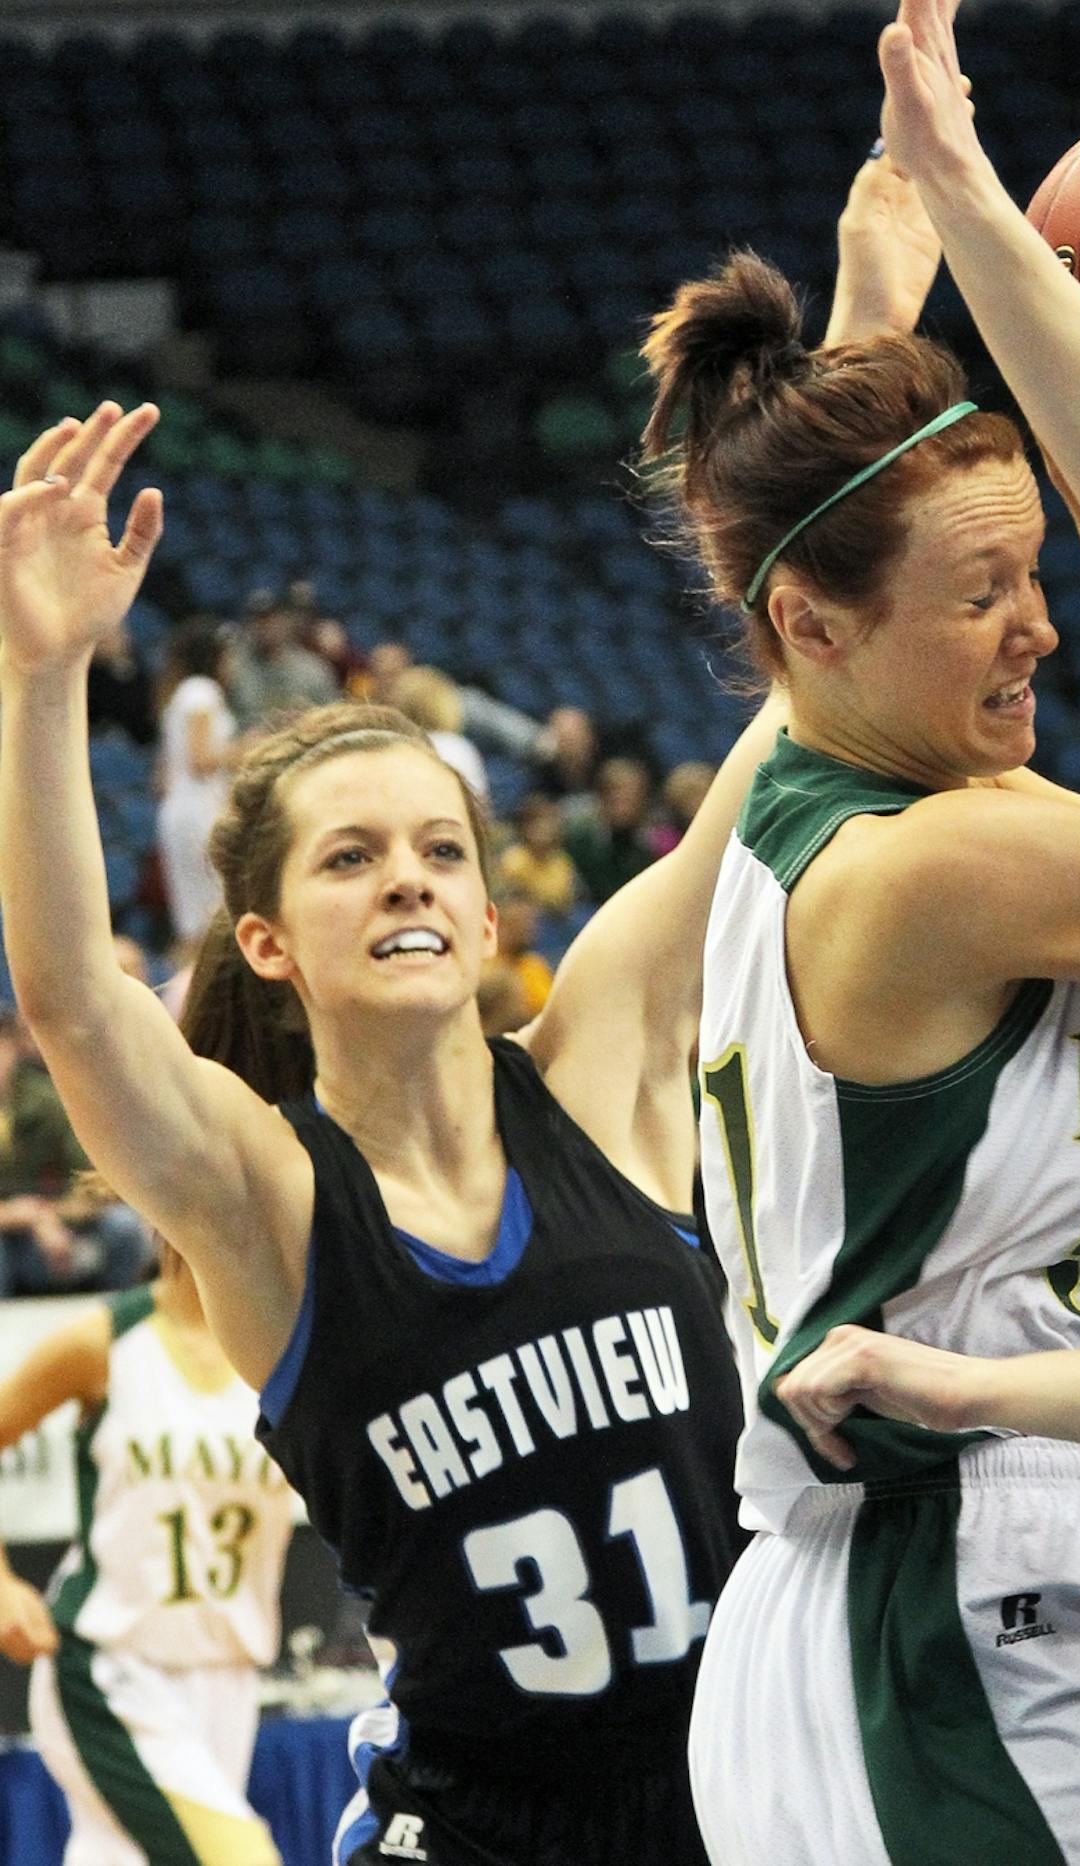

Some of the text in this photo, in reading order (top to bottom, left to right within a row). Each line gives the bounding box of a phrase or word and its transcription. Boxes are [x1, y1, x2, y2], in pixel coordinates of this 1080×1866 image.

[366, 1306, 691, 1511] EASTVIEW
[155, 1502, 258, 1605] 13
[462, 1467, 712, 1697] 31
